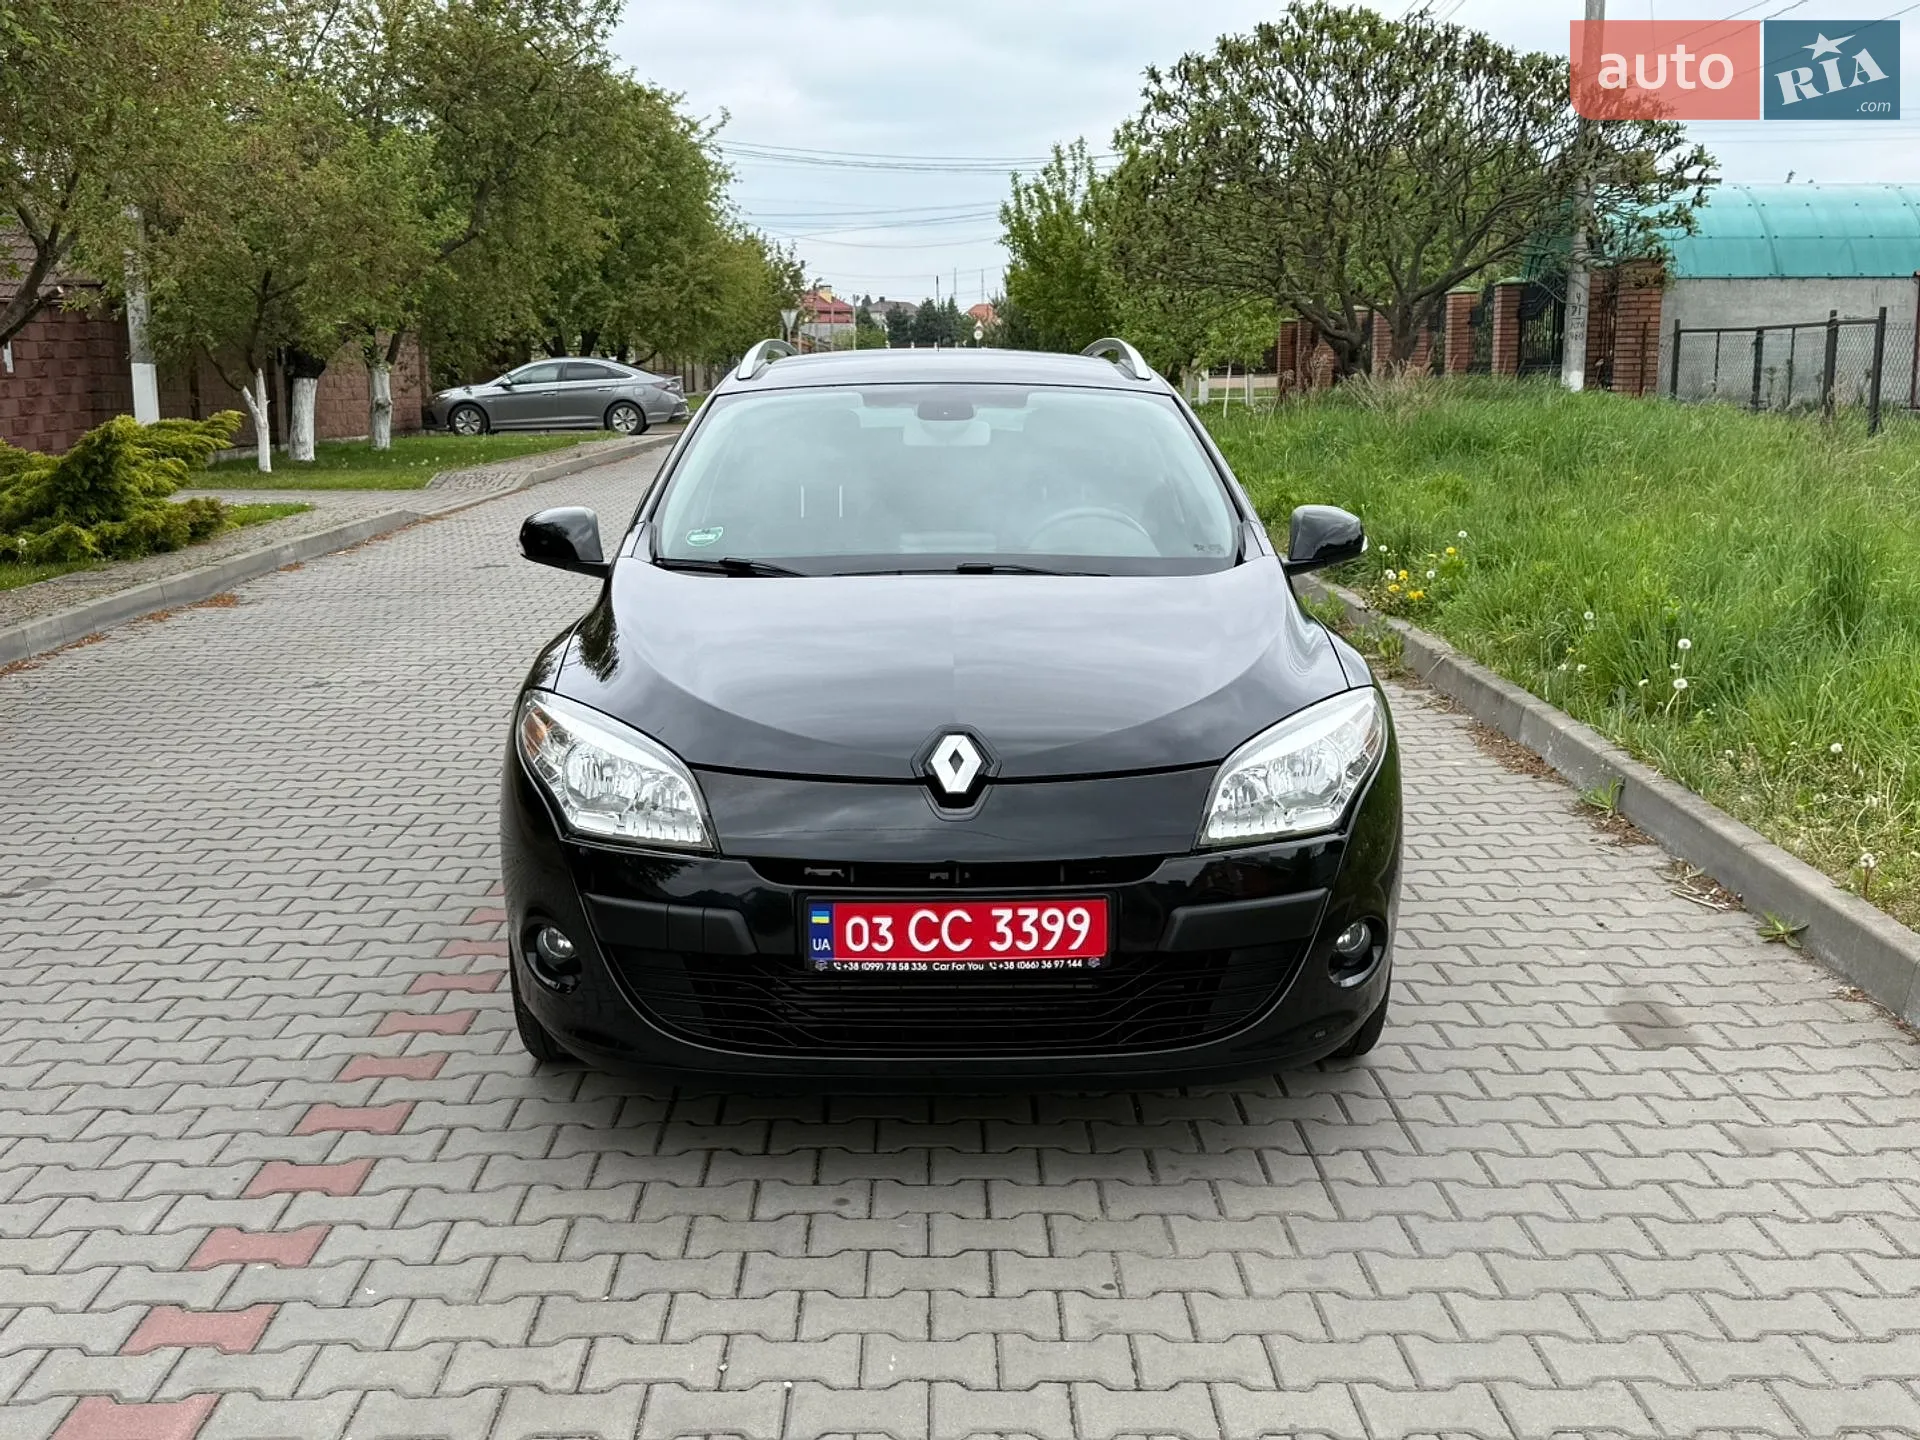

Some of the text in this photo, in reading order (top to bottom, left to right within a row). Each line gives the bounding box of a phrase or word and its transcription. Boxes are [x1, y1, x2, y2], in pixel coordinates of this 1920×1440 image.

[845, 907, 1092, 952] 03 CC 3399
[812, 938, 831, 951] UA
[842, 962, 859, 971] +38
[932, 962, 950, 971] Car
[952, 962, 966, 971] For
[967, 962, 984, 971] You
[998, 961, 1015, 970] +38
